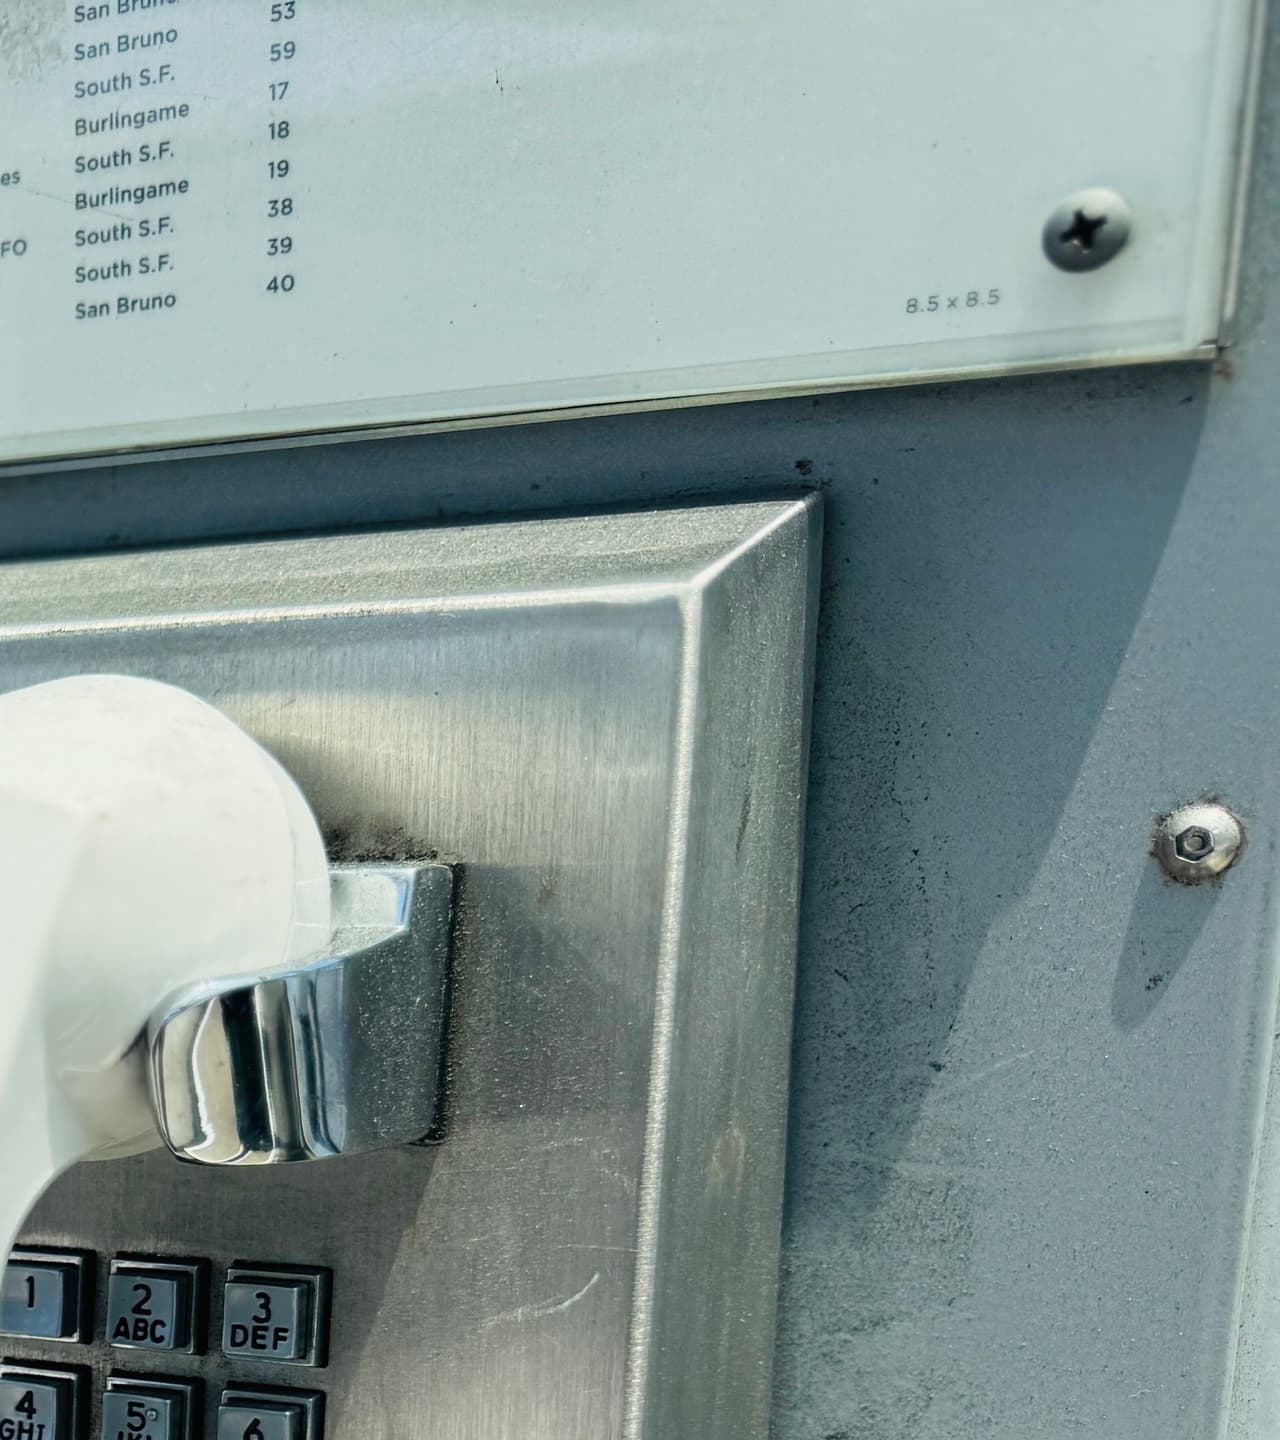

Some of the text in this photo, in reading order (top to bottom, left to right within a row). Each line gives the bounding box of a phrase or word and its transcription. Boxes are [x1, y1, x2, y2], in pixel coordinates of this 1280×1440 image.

[74, 3, 110, 23] San
[74, 41, 110, 61] San
[117, 28, 178, 53] Bruno
[270, 1, 296, 23] 53
[74, 72, 132, 99] South
[139, 64, 175, 87] S.F.
[270, 40, 296, 63] 59
[75, 103, 190, 137] Burlingame
[268, 81, 290, 102] 17
[75, 149, 132, 174] South
[139, 141, 174, 163] S.F.
[268, 120, 290, 141] 18
[75, 179, 189, 211] Burlingame
[267, 159, 290, 179] 19
[75, 223, 132, 248] South
[138, 216, 174, 238] S.F.
[267, 197, 293, 218] 38
[75, 260, 132, 284] South
[138, 254, 174, 275] S.F.
[266, 236, 293, 256] 39
[75, 301, 110, 320] San
[116, 293, 177, 315] Bruno
[266, 274, 295, 294] 40
[906, 295, 939, 315] 8.5
[966, 289, 1001, 308] 8.5
[24, 1275, 35, 1308] 1
[132, 1283, 152, 1316] 2
[253, 1291, 272, 1323] 3
[112, 1318, 166, 1345] ABC
[230, 1323, 289, 1351] DEF
[15, 1390, 34, 1420] 4
[126, 1402, 146, 1431] 5
